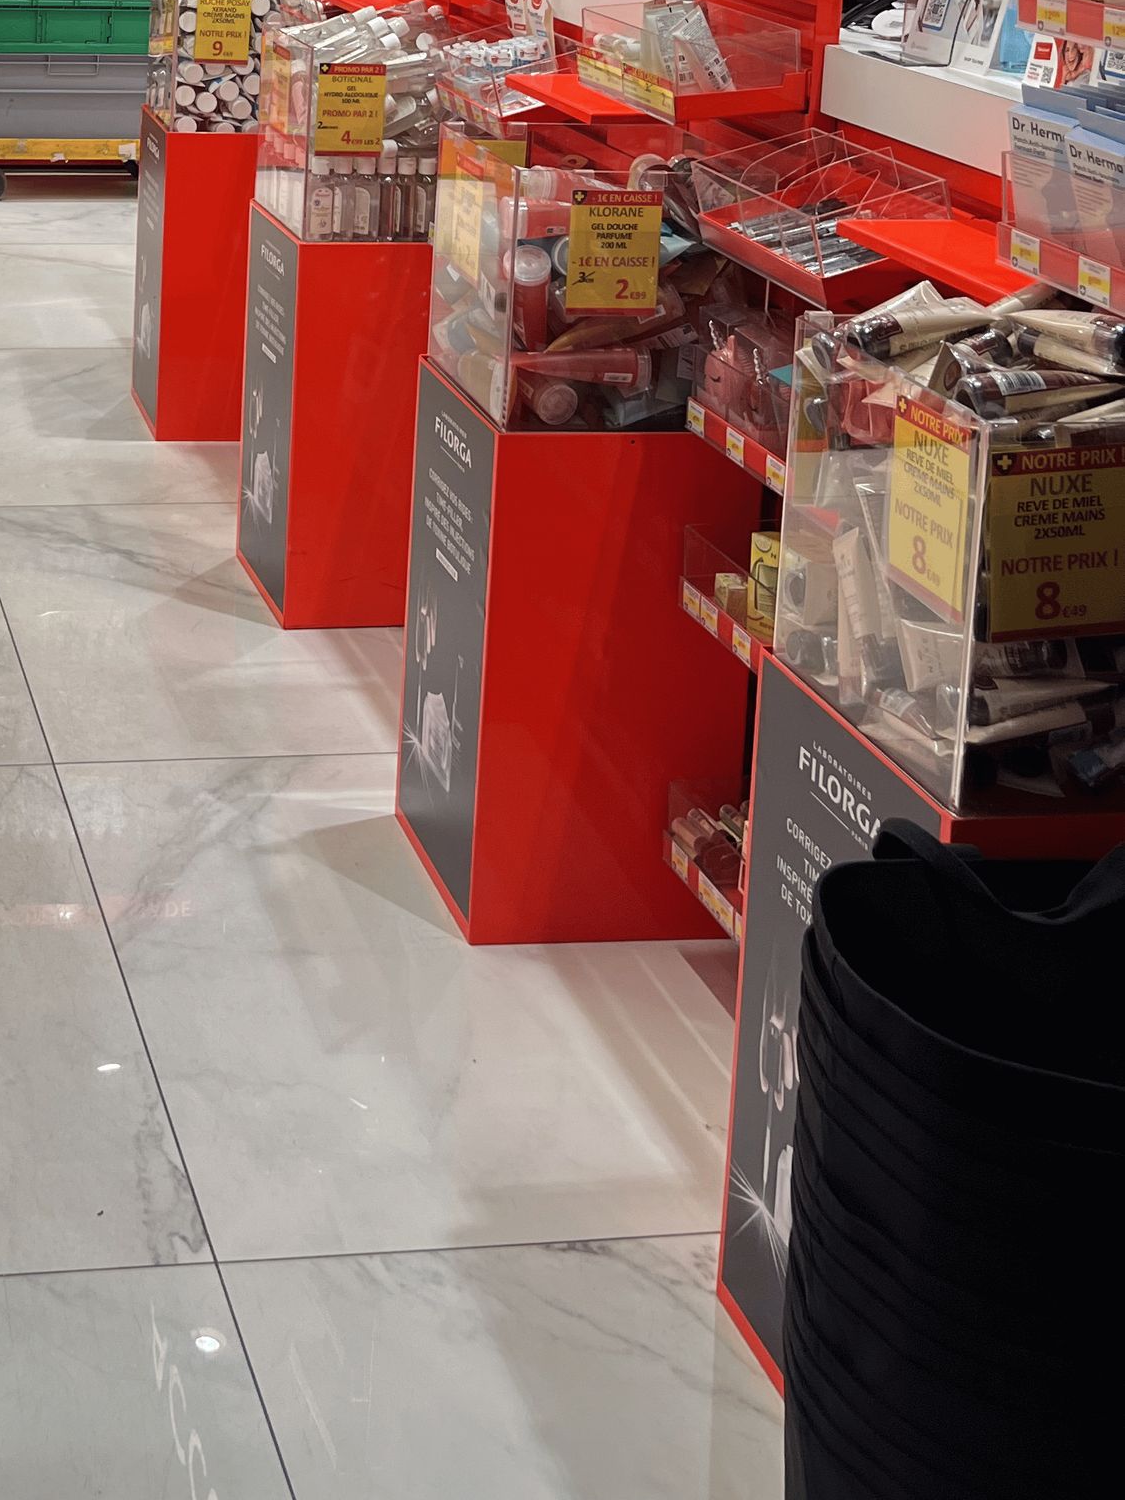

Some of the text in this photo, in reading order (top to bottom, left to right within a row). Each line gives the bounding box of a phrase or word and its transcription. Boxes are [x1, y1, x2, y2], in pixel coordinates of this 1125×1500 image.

[200, 30, 224, 38] NOTRE
[1012, 117, 1065, 142] Dr Herm
[1069, 144, 1123, 174] Dr Herma
[610, 194, 621, 202] EN
[623, 194, 652, 202] CAISSE
[589, 207, 644, 217] KLORANE
[591, 223, 639, 231] GEL DOUCHE
[596, 232, 633, 240] PARFUME
[261, 244, 285, 276] FILORGA
[579, 256, 648, 267] 1€ EN CAISSE
[911, 405, 965, 447] NOTRE PRIX
[434, 416, 472, 468] FILORGA
[914, 430, 949, 467] NUXE
[906, 448, 954, 485] REVE DE MIEL
[1021, 449, 1115, 470] NOTRE PRIX
[1030, 474, 1093, 497] NUXE
[1017, 495, 1103, 512] REVE DE MIEL
[895, 499, 953, 549] NOTRE PRIX
[1014, 509, 1105, 528] CREME MAINS
[1034, 527, 1085, 540] 2X50ML
[1001, 555, 1062, 576] NOTRE
[1067, 551, 1107, 571] PRIX
[813, 740, 872, 801] LABORATOIRES
[787, 818, 832, 868] CORRIGEZ
[777, 855, 813, 904] INSPIRÉ
[781, 884, 793, 908] DE
